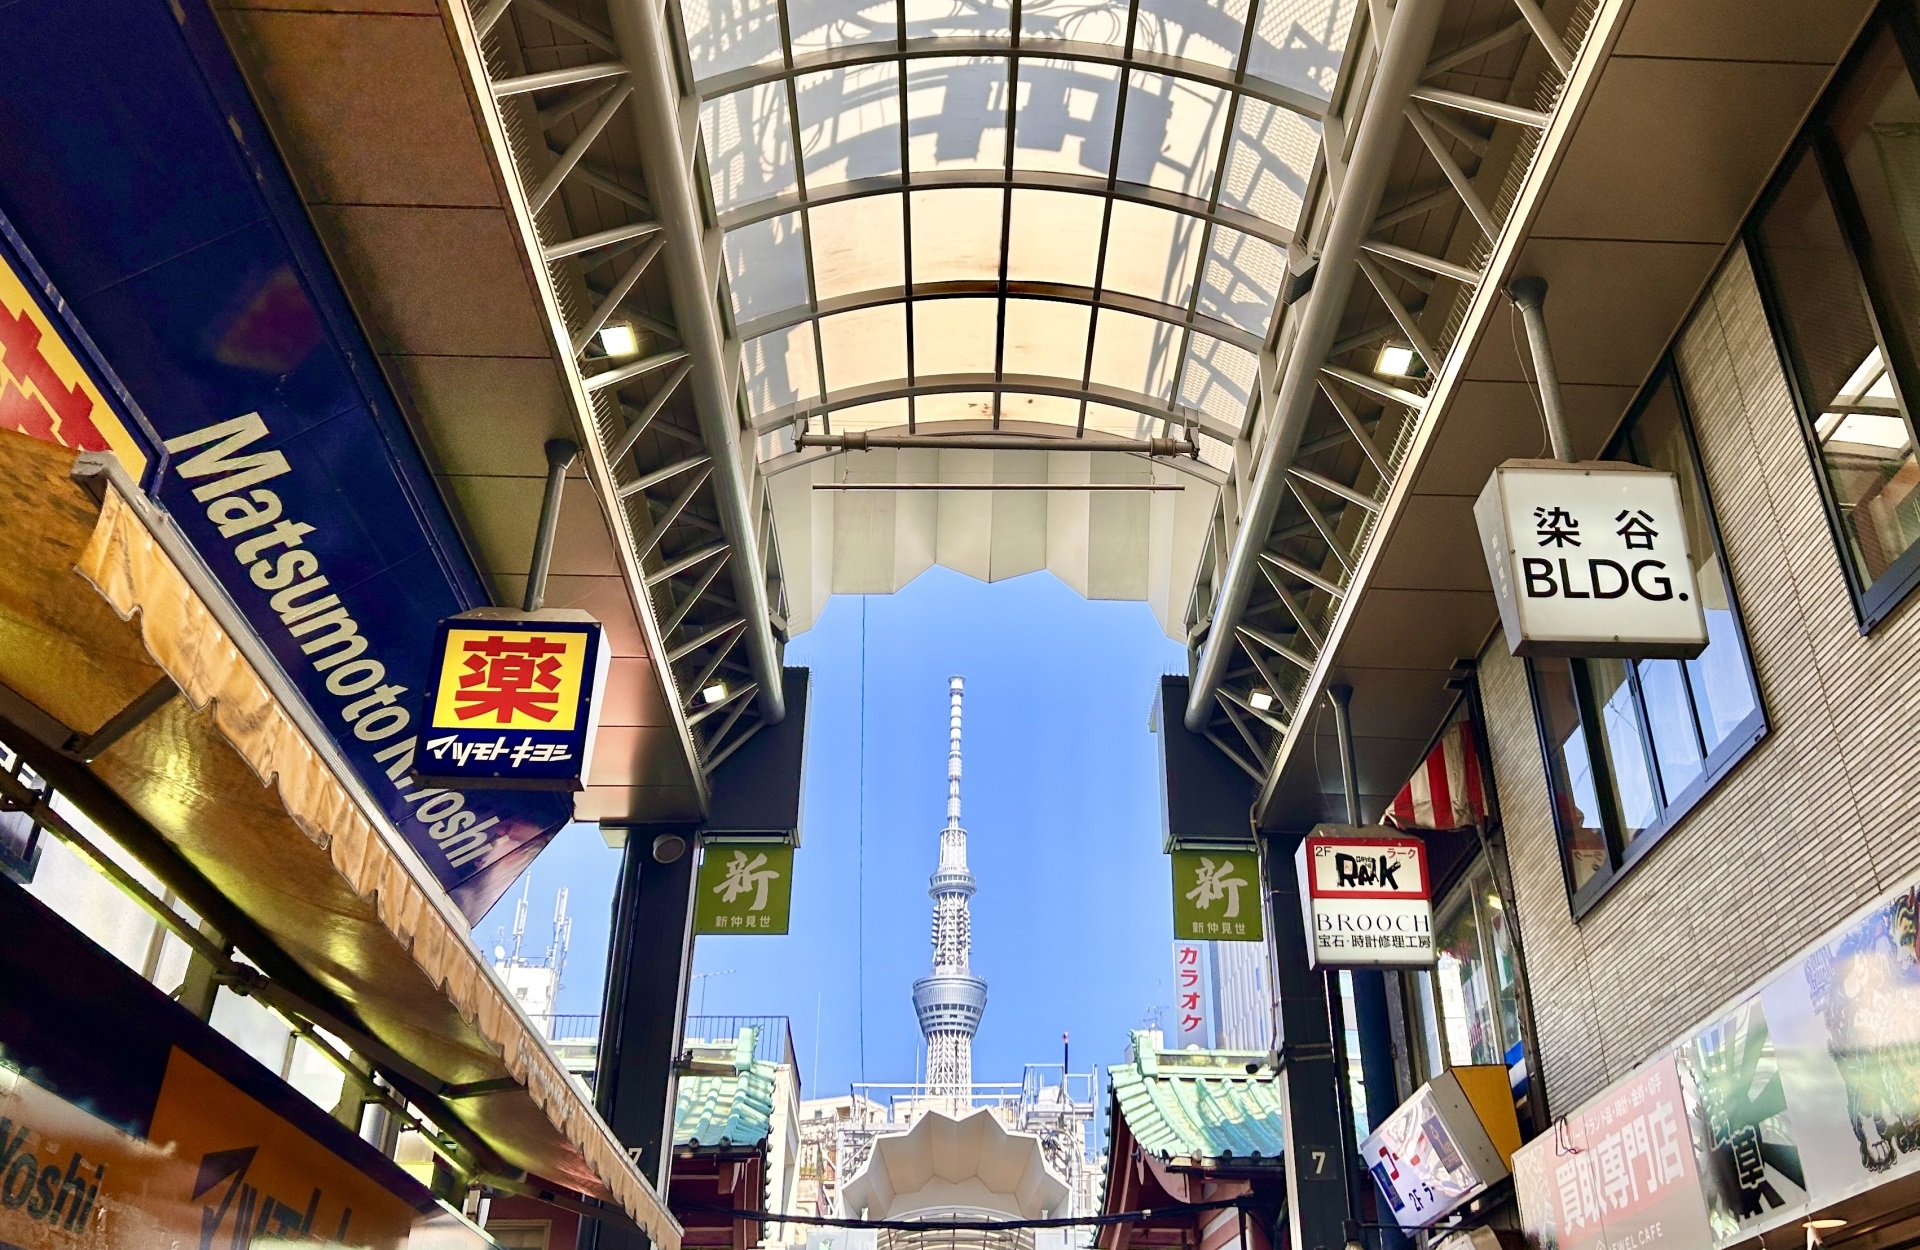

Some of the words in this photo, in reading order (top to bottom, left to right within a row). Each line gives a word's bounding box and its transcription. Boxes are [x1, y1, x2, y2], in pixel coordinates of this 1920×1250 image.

[163, 411, 411, 742] Matsumoto
[1522, 557, 1689, 602] BLDG.
[454, 635, 567, 724] 薬
[426, 734, 572, 768] マツモトキヨシ
[1315, 846, 1332, 857] 2F
[1387, 848, 1416, 859] ラーク
[713, 850, 780, 911] 新
[1185, 857, 1249, 918] 新
[715, 915, 771, 928] 新仲見世
[1191, 921, 1246, 935] 新仲見世
[1316, 913, 1430, 932] BROOCH
[1318, 934, 1431, 948] 宝石・時計修理工房
[1179, 947, 1202, 1032] カラオケ
[1311, 1151, 1326, 1174] 7
[1555, 1100, 1685, 1237] 買取専門店
[1408, 1189, 1425, 1212] 2F
[1638, 1222, 1663, 1245] CAFE
